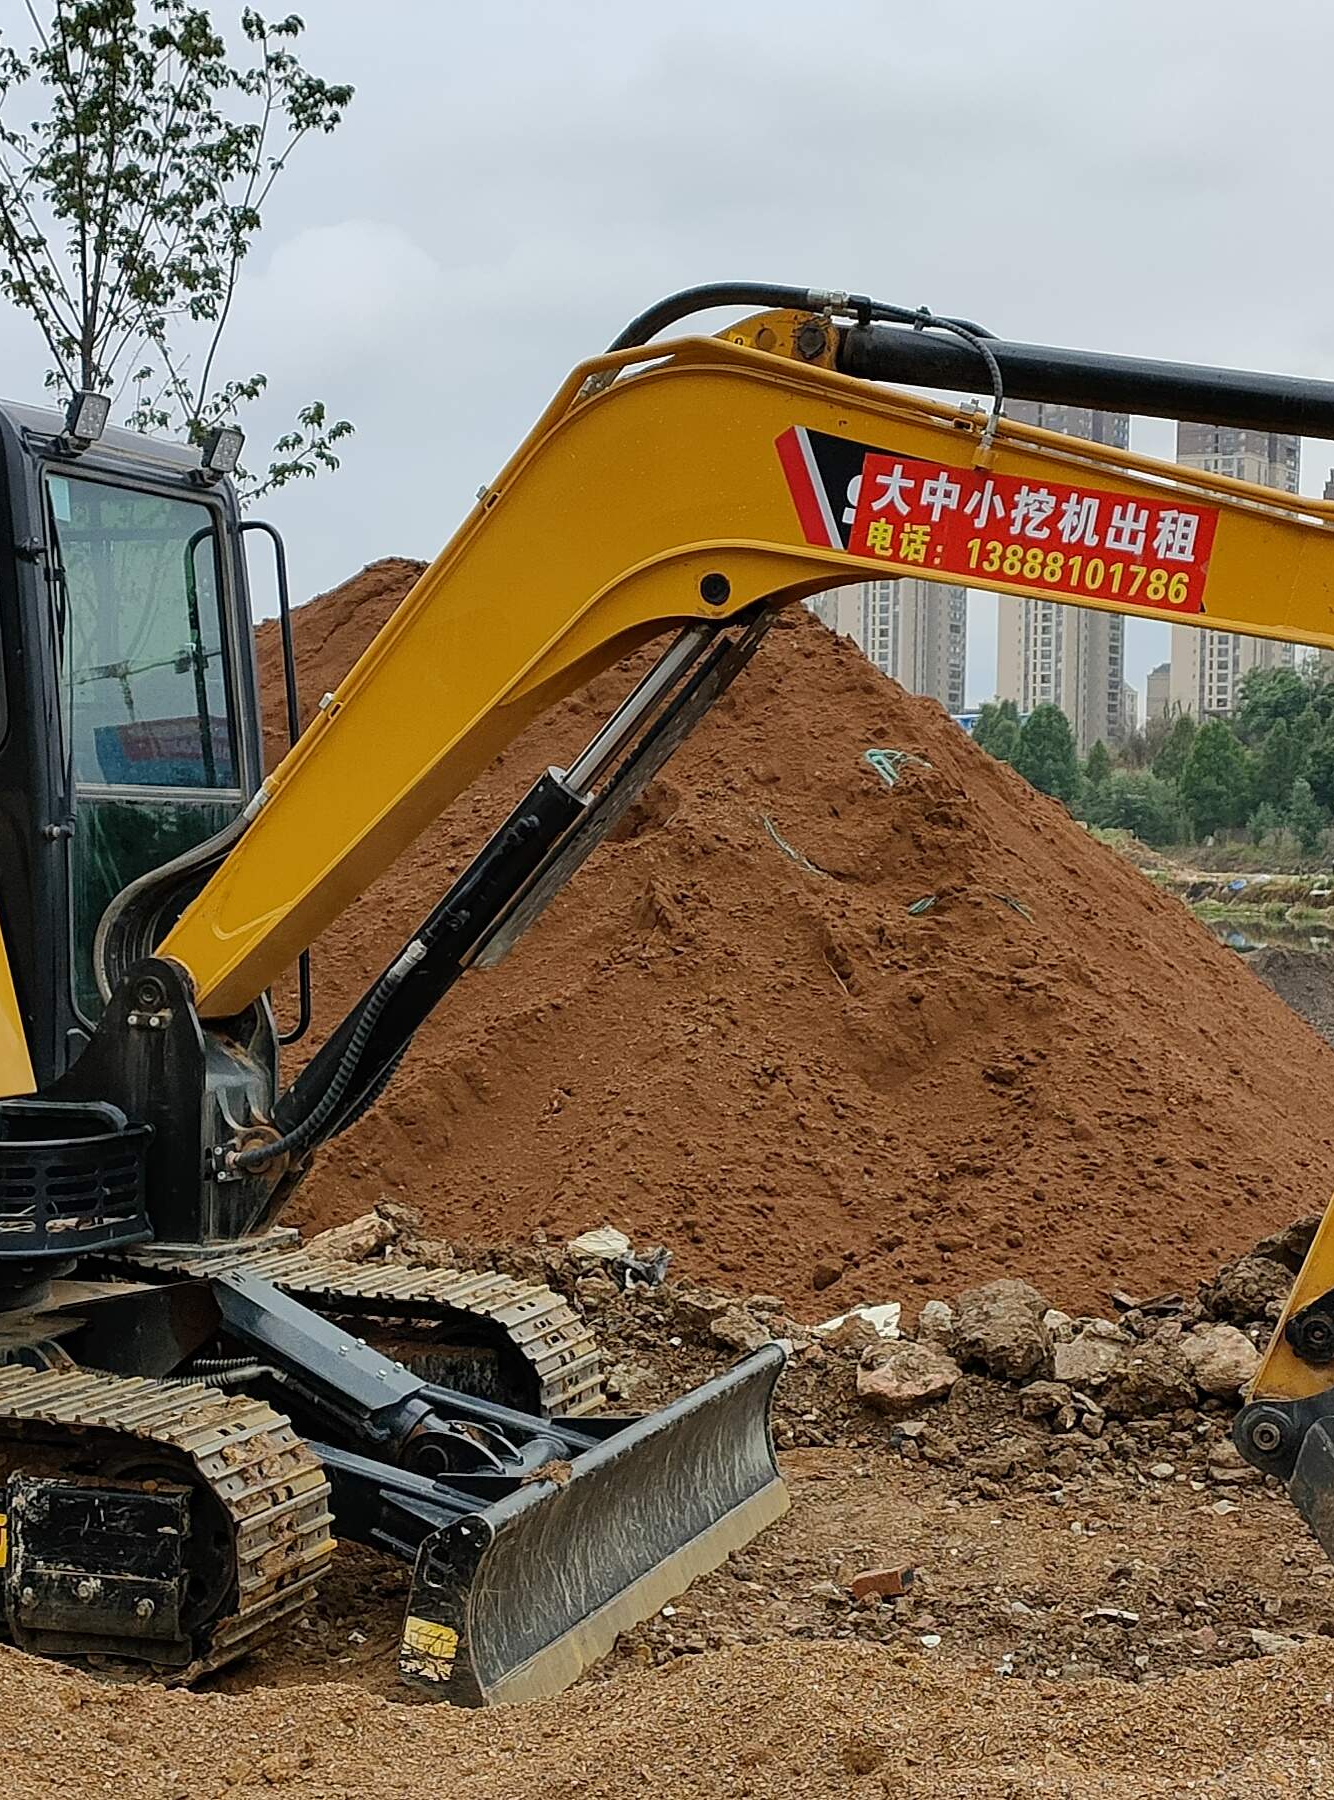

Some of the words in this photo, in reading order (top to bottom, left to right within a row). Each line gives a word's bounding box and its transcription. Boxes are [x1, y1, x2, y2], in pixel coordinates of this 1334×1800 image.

[870, 464, 1201, 564] 大中小挖机出租
[966, 538, 1190, 604] 13888101786
